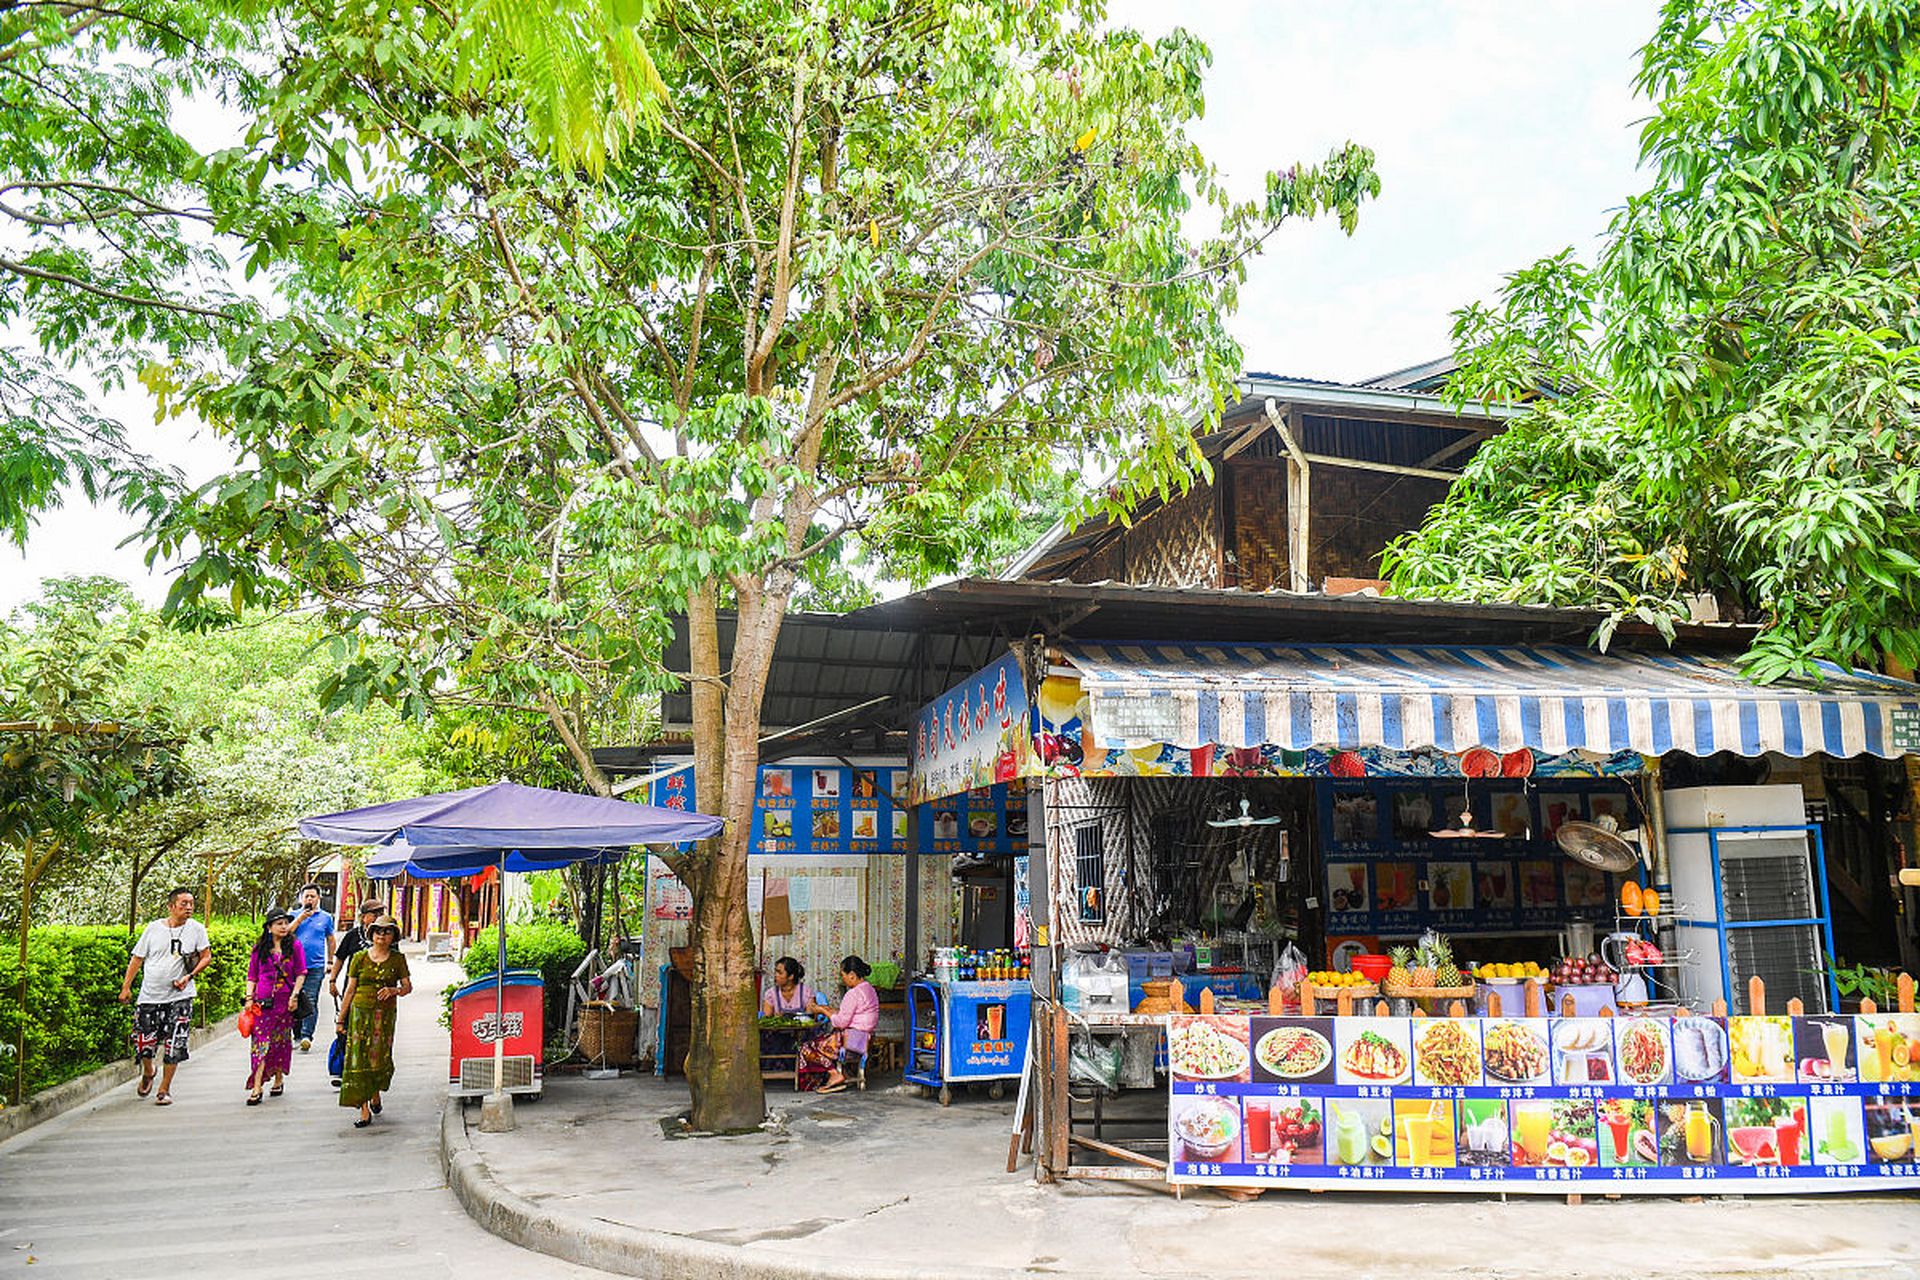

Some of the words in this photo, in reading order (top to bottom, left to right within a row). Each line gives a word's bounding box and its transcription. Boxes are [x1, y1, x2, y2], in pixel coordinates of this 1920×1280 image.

[1194, 1084, 1217, 1095] 炒饭
[1277, 1084, 1299, 1096] 炒面
[1741, 1085, 1776, 1096] 香蕉汁
[1810, 1084, 1845, 1095] 苹果汁
[1255, 1164, 1291, 1176] 草莓汁
[1338, 1167, 1386, 1178] 牛油果汁
[1410, 1168, 1445, 1179] 芒果汁
[1470, 1168, 1505, 1180] 椰子汁
[1612, 1167, 1647, 1179] 木瓜汁
[1682, 1167, 1717, 1179] 菠萝汁
[1756, 1166, 1790, 1178] 西瓜汁
[1825, 1165, 1860, 1177] 柠檬汁
